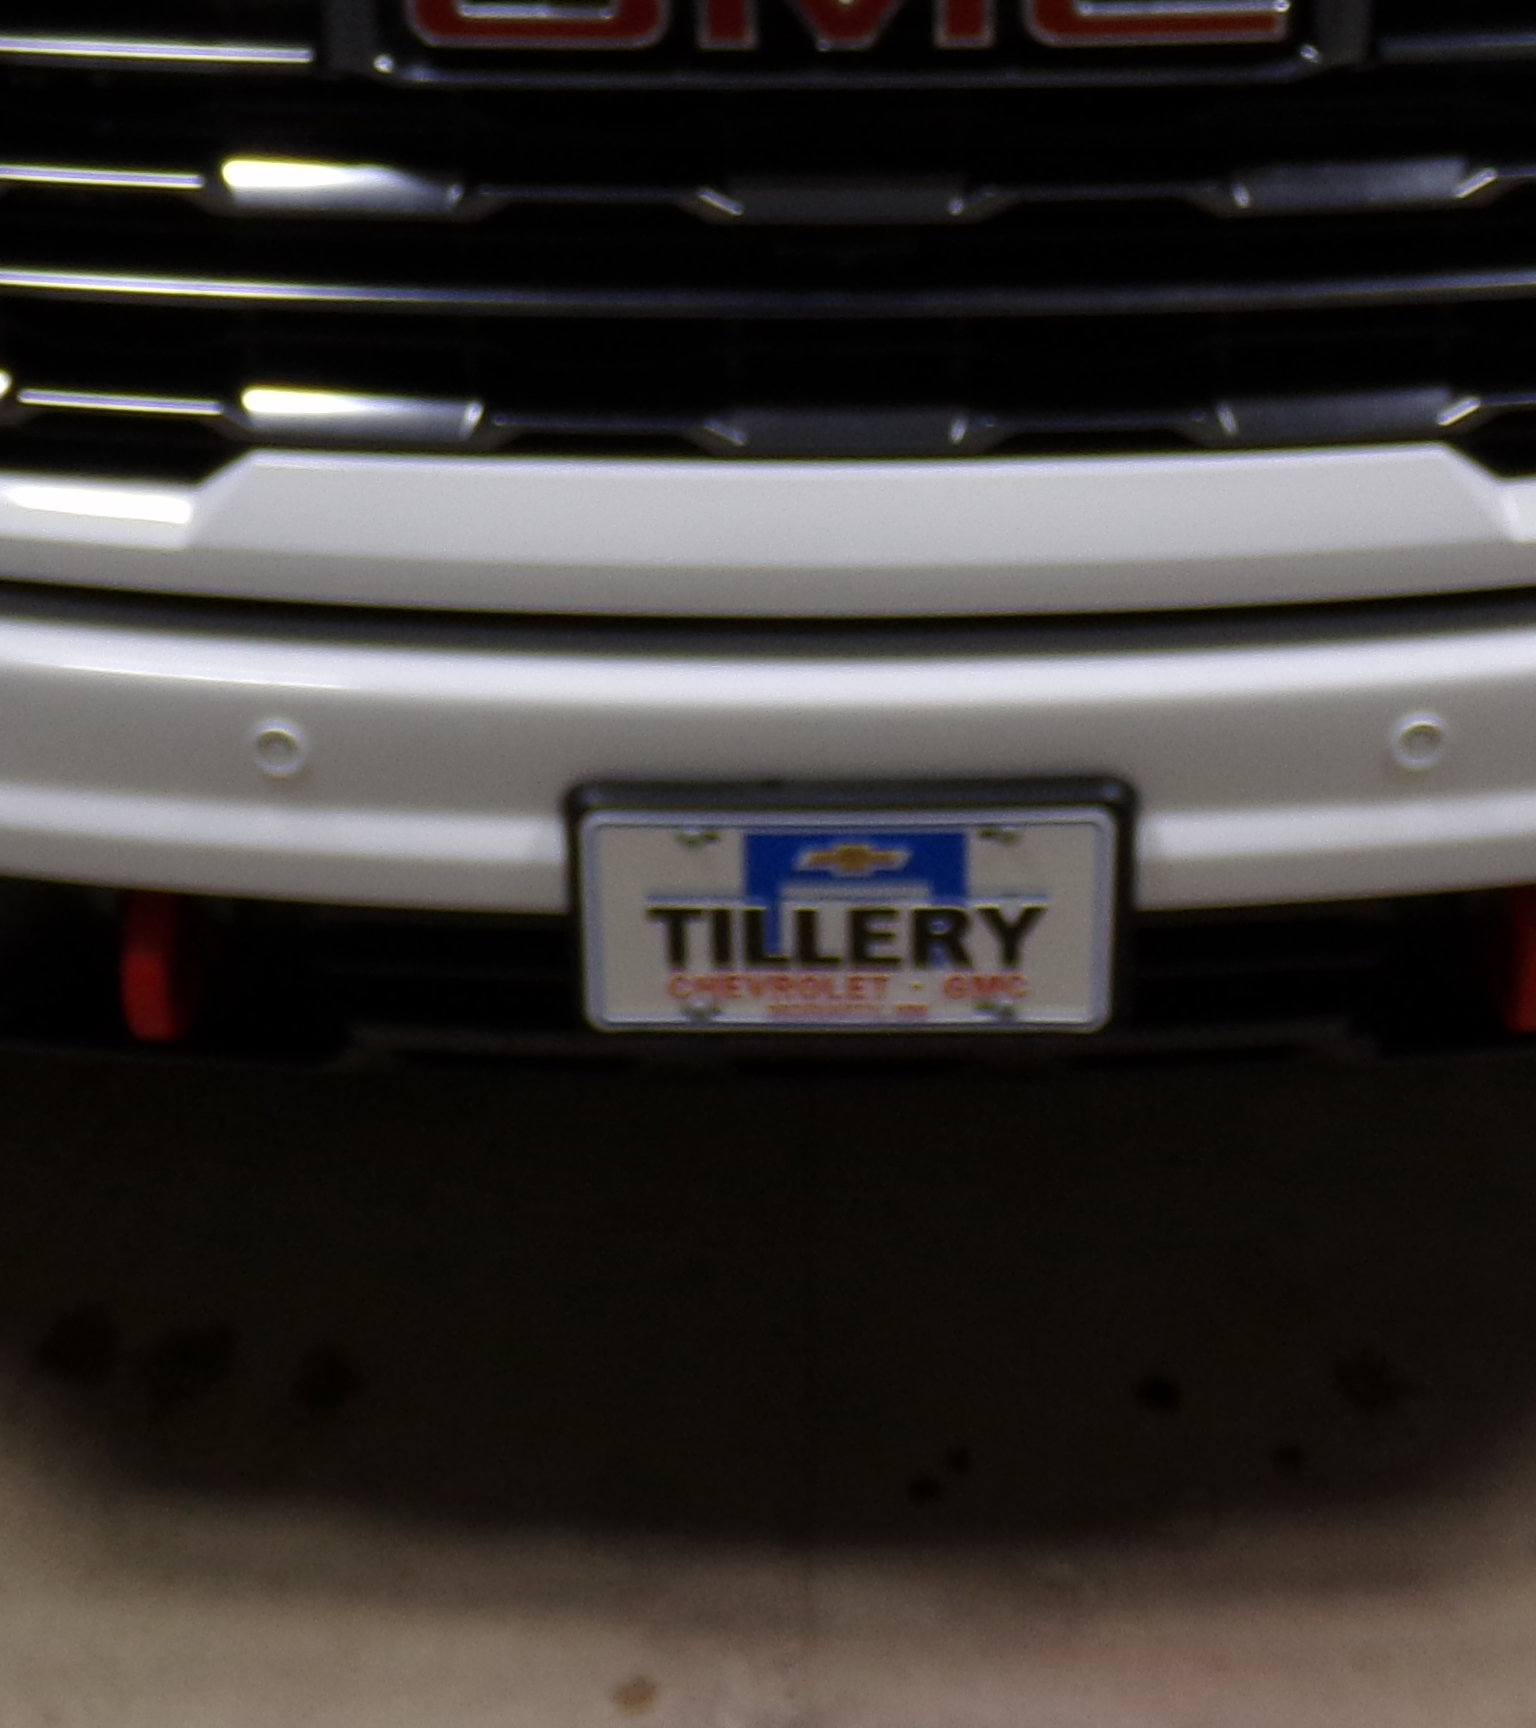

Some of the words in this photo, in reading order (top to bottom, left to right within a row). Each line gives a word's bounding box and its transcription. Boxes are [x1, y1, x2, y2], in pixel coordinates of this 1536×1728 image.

[645, 904, 1049, 970] TILLERY
[667, 973, 891, 1001] CHEVROLET
[942, 973, 1030, 1001] GMC
